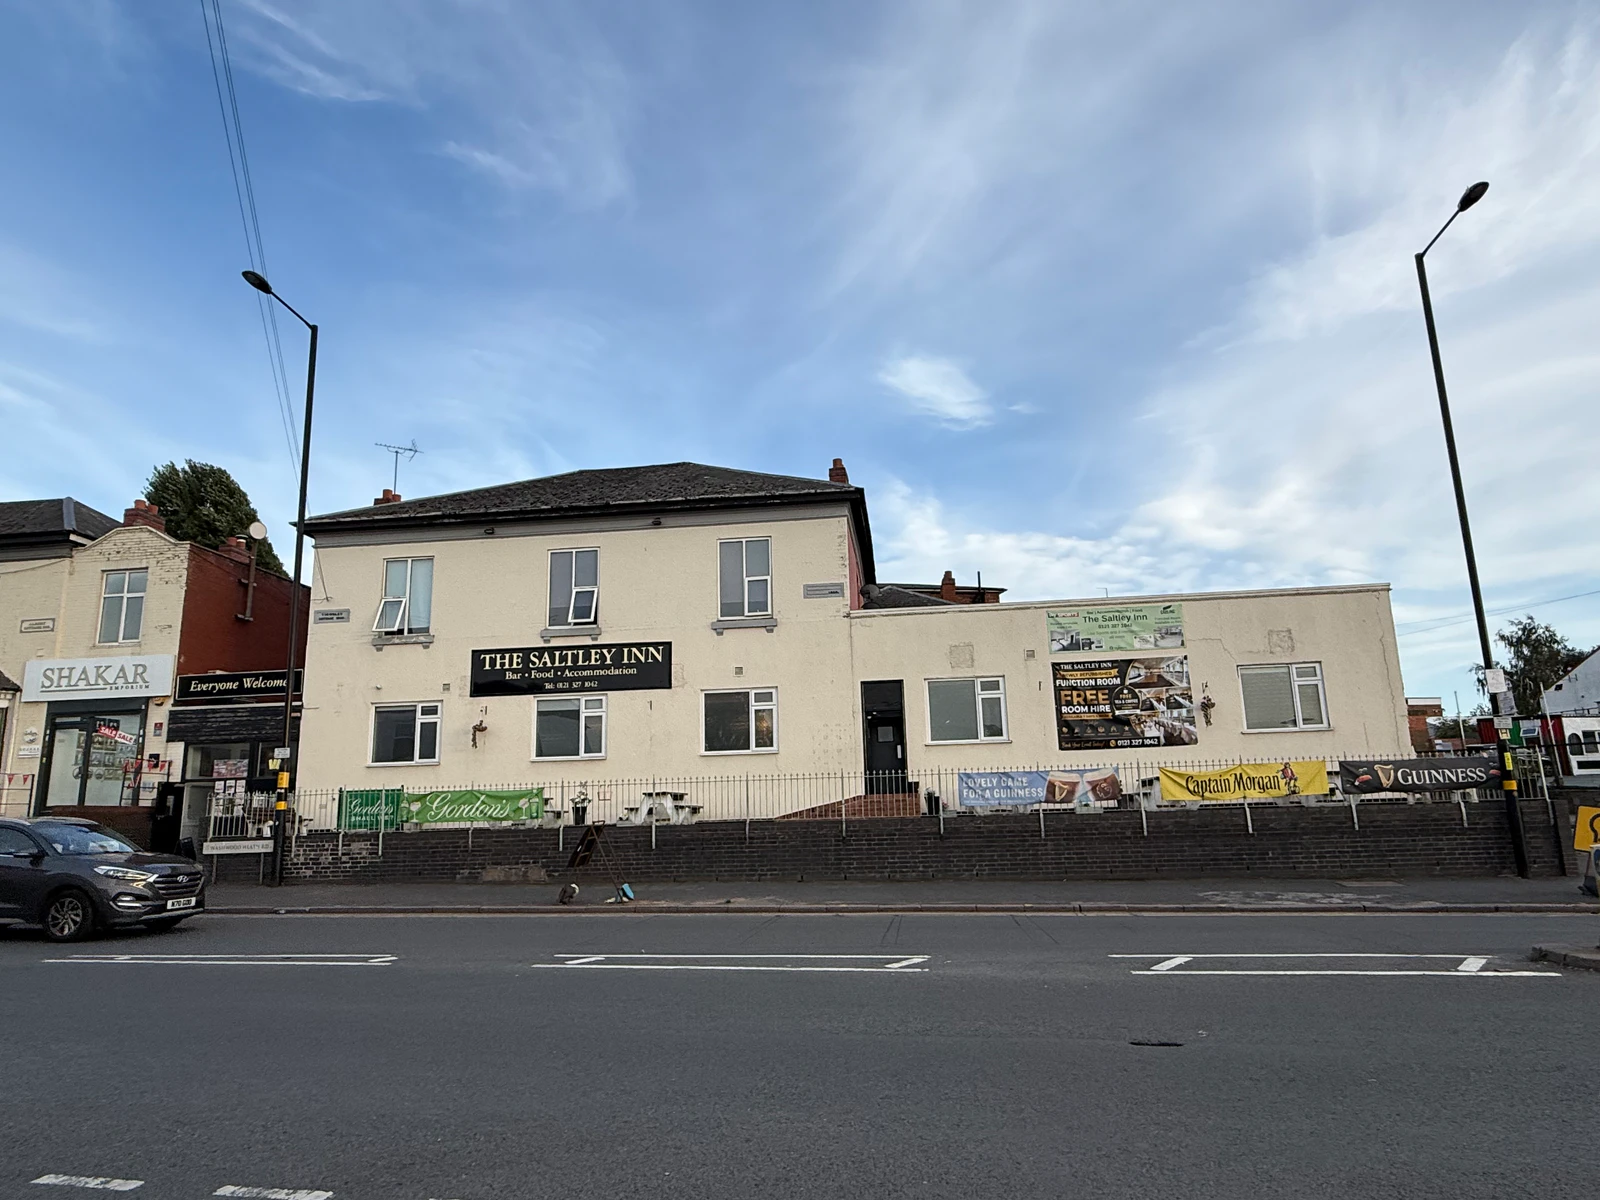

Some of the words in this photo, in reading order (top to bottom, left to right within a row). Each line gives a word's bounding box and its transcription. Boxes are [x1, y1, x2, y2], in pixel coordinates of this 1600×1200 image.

[1082, 615, 1099, 623] The
[1101, 613, 1131, 623] Saltley
[1133, 613, 1148, 621] Inn
[480, 652, 523, 671] THE
[529, 648, 617, 669] SALTLEY
[621, 645, 664, 664] INN
[40, 663, 150, 689] SHAKAR
[505, 671, 522, 680] Bar
[530, 668, 554, 679] Food
[562, 667, 637, 678] Accommodation
[189, 680, 240, 693] Everyone
[242, 676, 288, 689] Welcome
[584, 680, 598, 688] 1042
[1056, 679, 1096, 687] FUNCTION
[1096, 678, 1120, 686] ROOM
[1060, 689, 1110, 705] FREE
[1061, 705, 1088, 714] ROOM
[1090, 704, 1111, 713] HIRE
[100, 726, 117, 737] SALE
[116, 733, 134, 743] SALE
[963, 778, 998, 787] LOVELY
[1001, 777, 1029, 787] GAME
[1185, 774, 1231, 797] Captain
[1230, 772, 1281, 794] Morgan
[1397, 768, 1487, 785] GUINNESS
[984, 788, 991, 798] A
[993, 788, 1044, 798] GUINNESS
[348, 798, 394, 815] Gordon's
[426, 793, 511, 821] Gordon's
